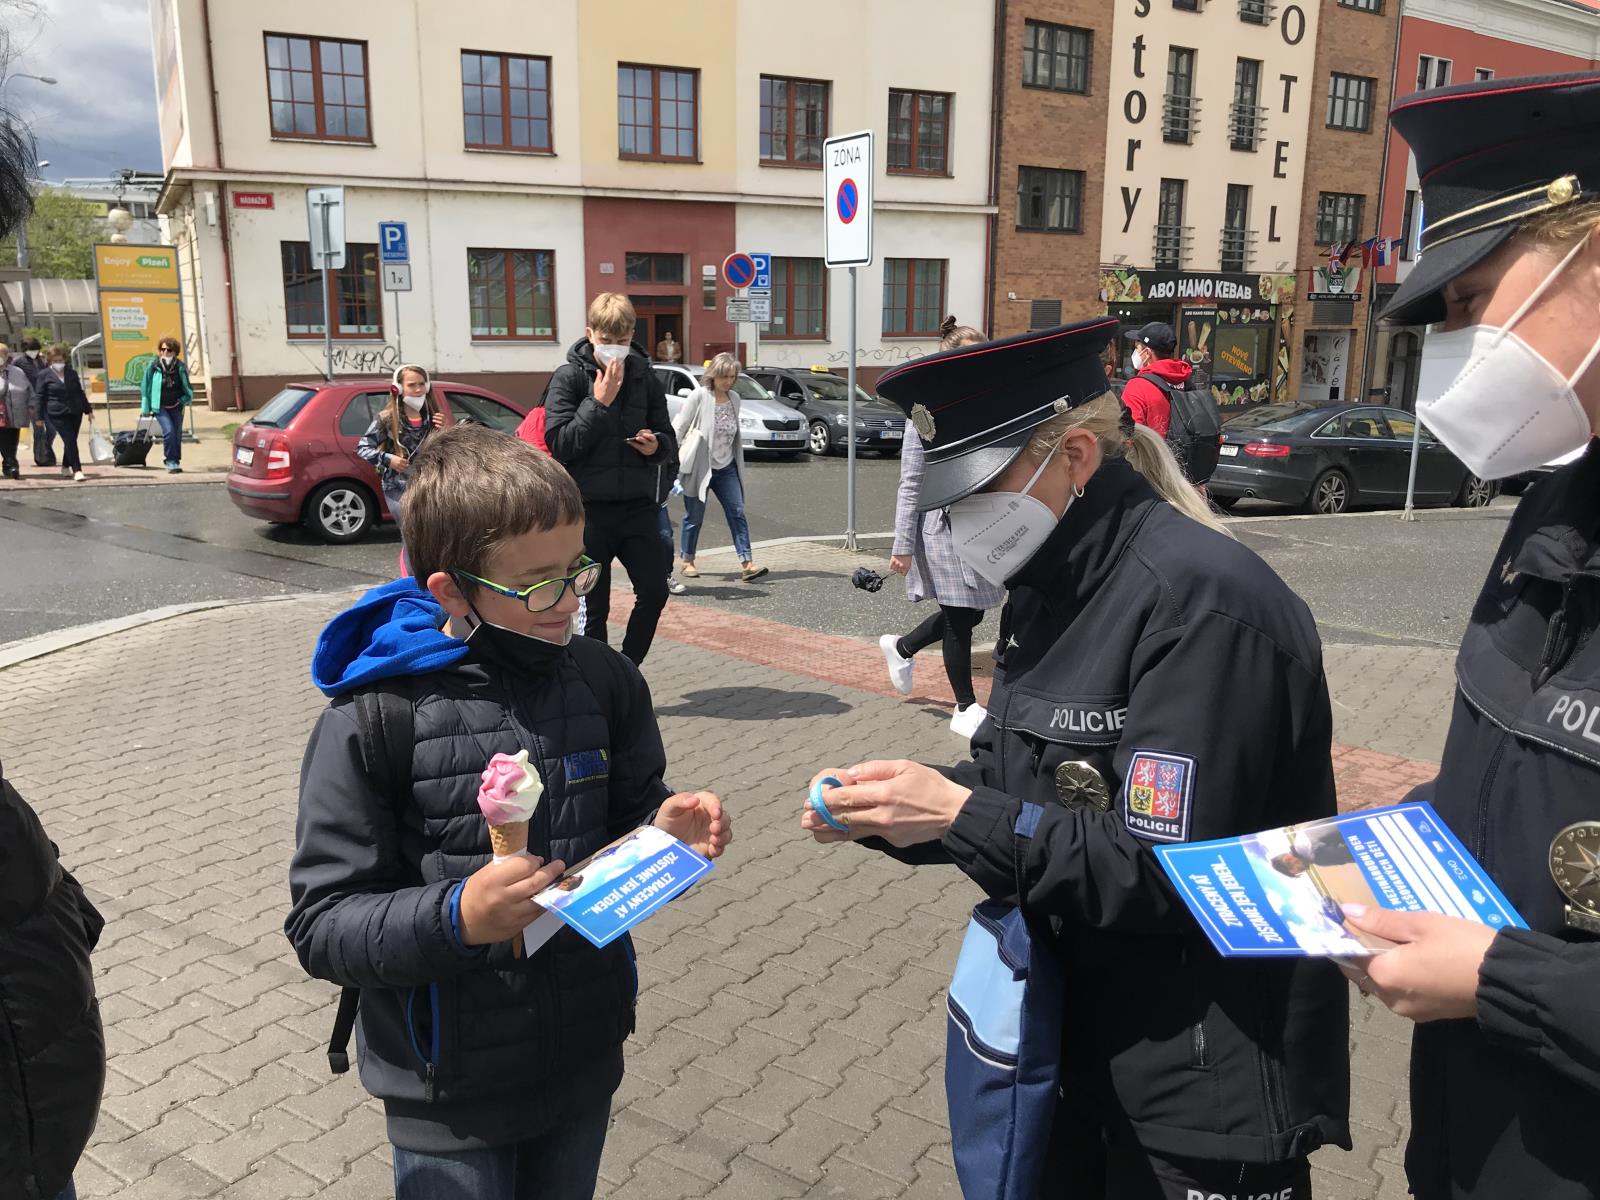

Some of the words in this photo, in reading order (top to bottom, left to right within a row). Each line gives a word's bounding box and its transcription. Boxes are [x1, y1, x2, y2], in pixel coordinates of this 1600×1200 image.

[833, 145, 862, 167] ZÓNA
[385, 226, 402, 250] P
[103, 256, 131, 267] Enjoy
[141, 256, 169, 267] Plzeň
[1148, 280, 1175, 299] ABO
[1177, 278, 1213, 298] HAMO
[1214, 280, 1252, 300] KEBAB
[1050, 707, 1128, 733] POLICIE
[1129, 814, 1180, 834] POLICIE
[1347, 834, 1363, 851] DEN
[620, 876, 640, 894] JEN
[626, 872, 676, 911] ZTRACENÝ
[1380, 857, 1423, 912] ŘEŠOVANÝCH
[1228, 891, 1256, 906] JEN
